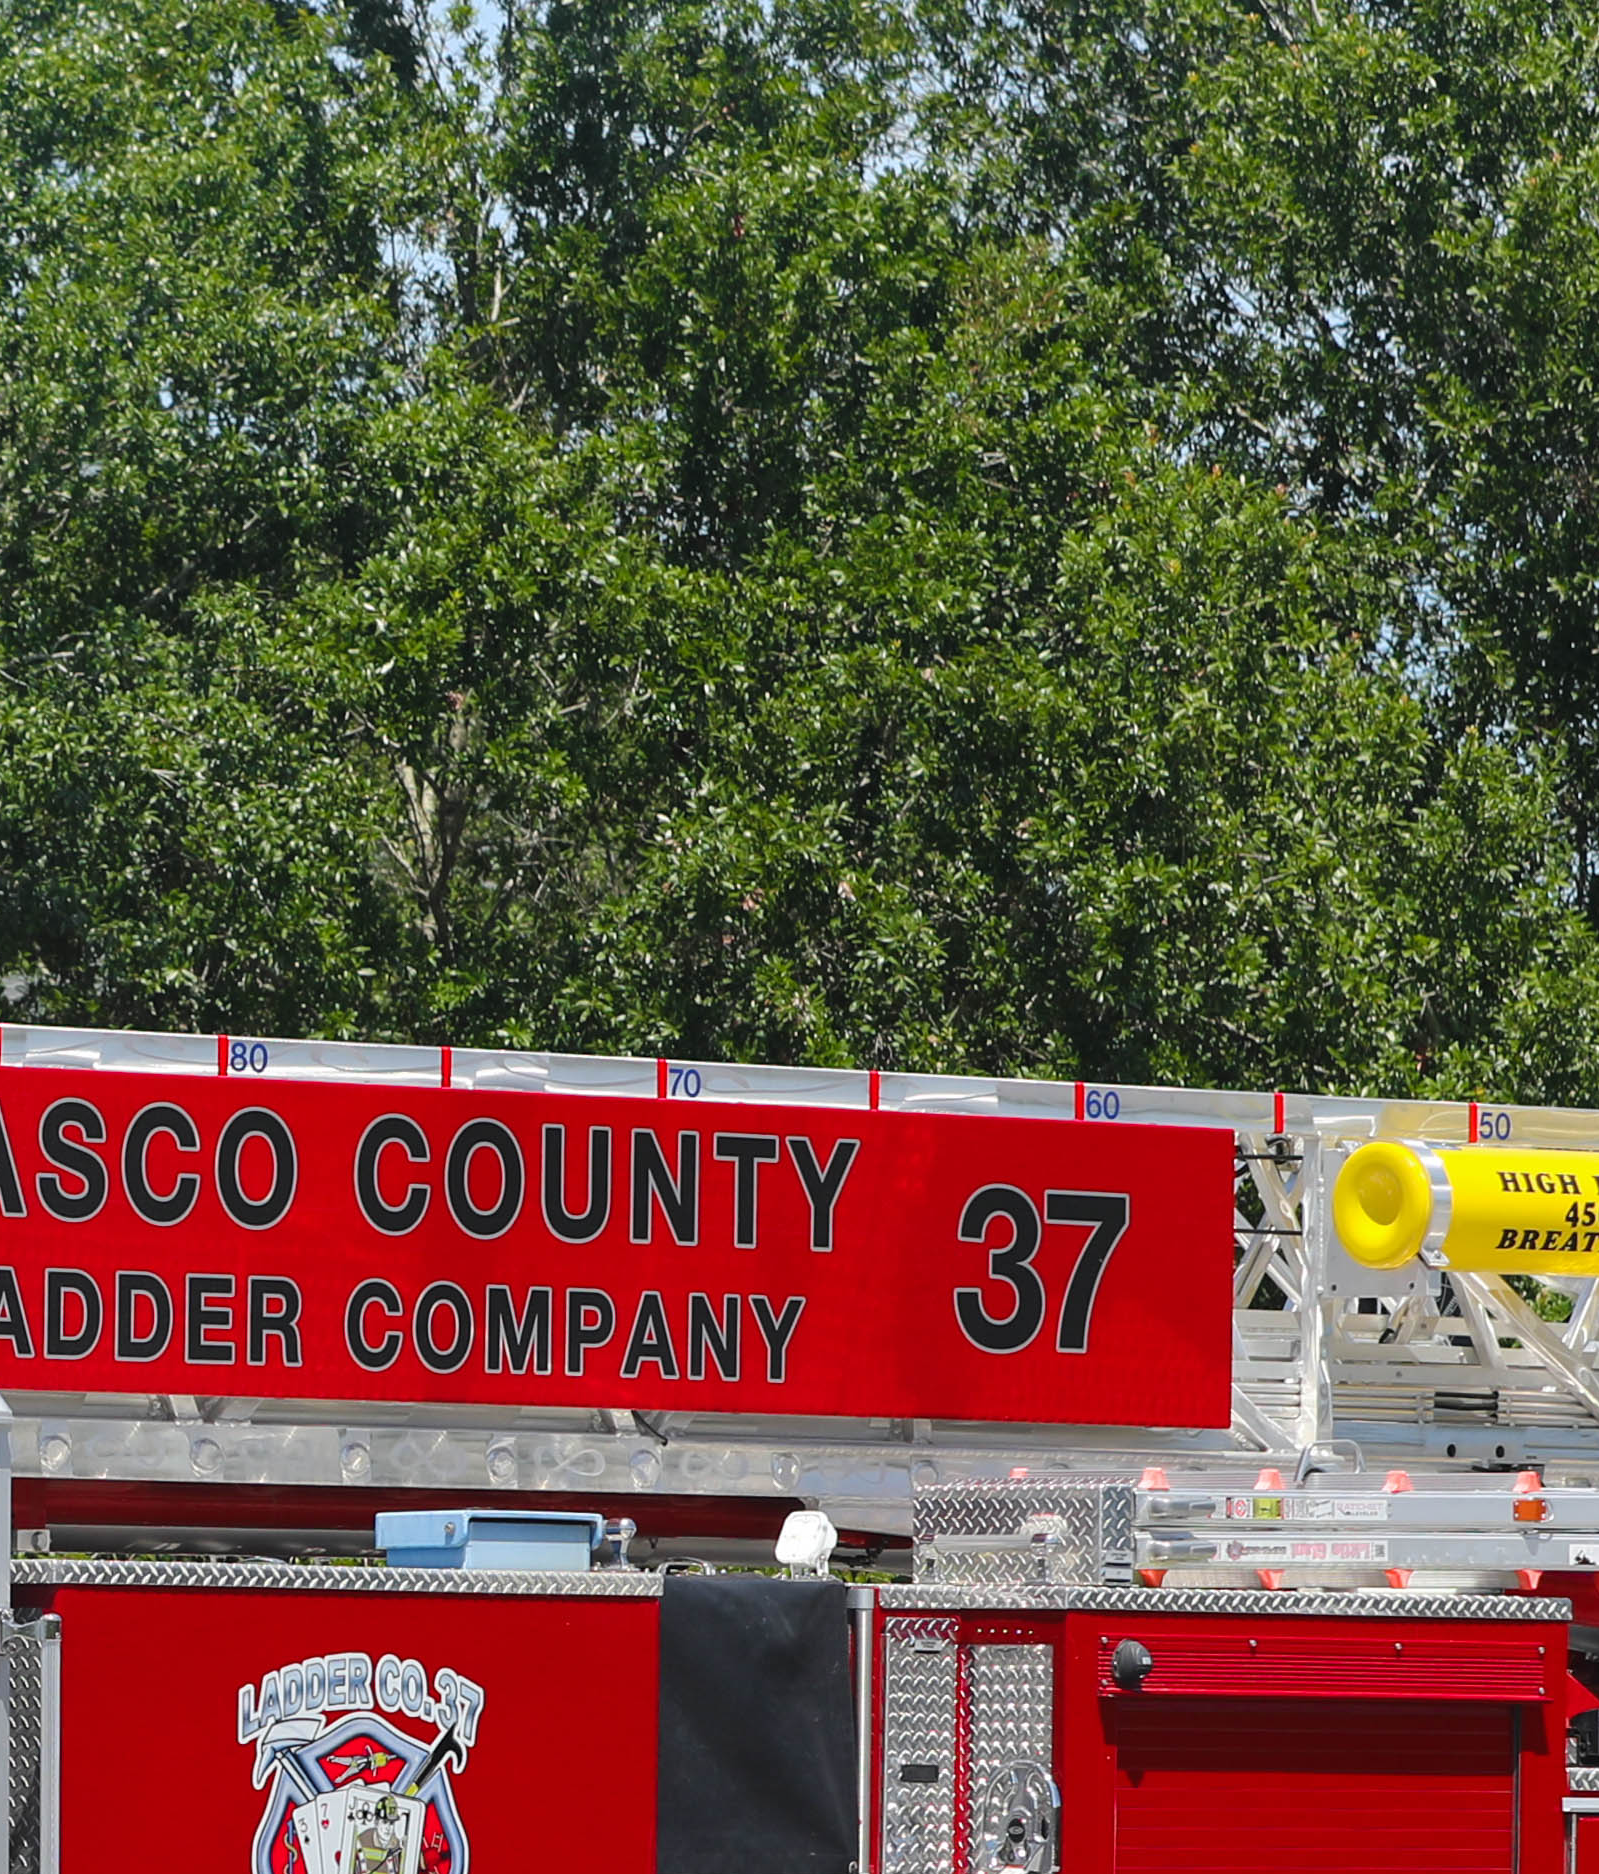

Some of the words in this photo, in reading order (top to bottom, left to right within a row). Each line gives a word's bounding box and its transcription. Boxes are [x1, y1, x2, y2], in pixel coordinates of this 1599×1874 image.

[230, 1042, 268, 1073] 80
[668, 1068, 702, 1098] 70
[1085, 1089, 1120, 1120] 60
[1479, 1111, 1511, 1141] 50
[353, 1112, 861, 1252] COUNTY
[1496, 1171, 1581, 1195] HIGH
[953, 1182, 1131, 1355] 37
[344, 1276, 806, 1384] COMPANY
[239, 1657, 372, 1740] LADDER
[377, 1657, 433, 1718] CO.
[437, 1672, 483, 1742] 37
[320, 1802, 329, 1819] 7
